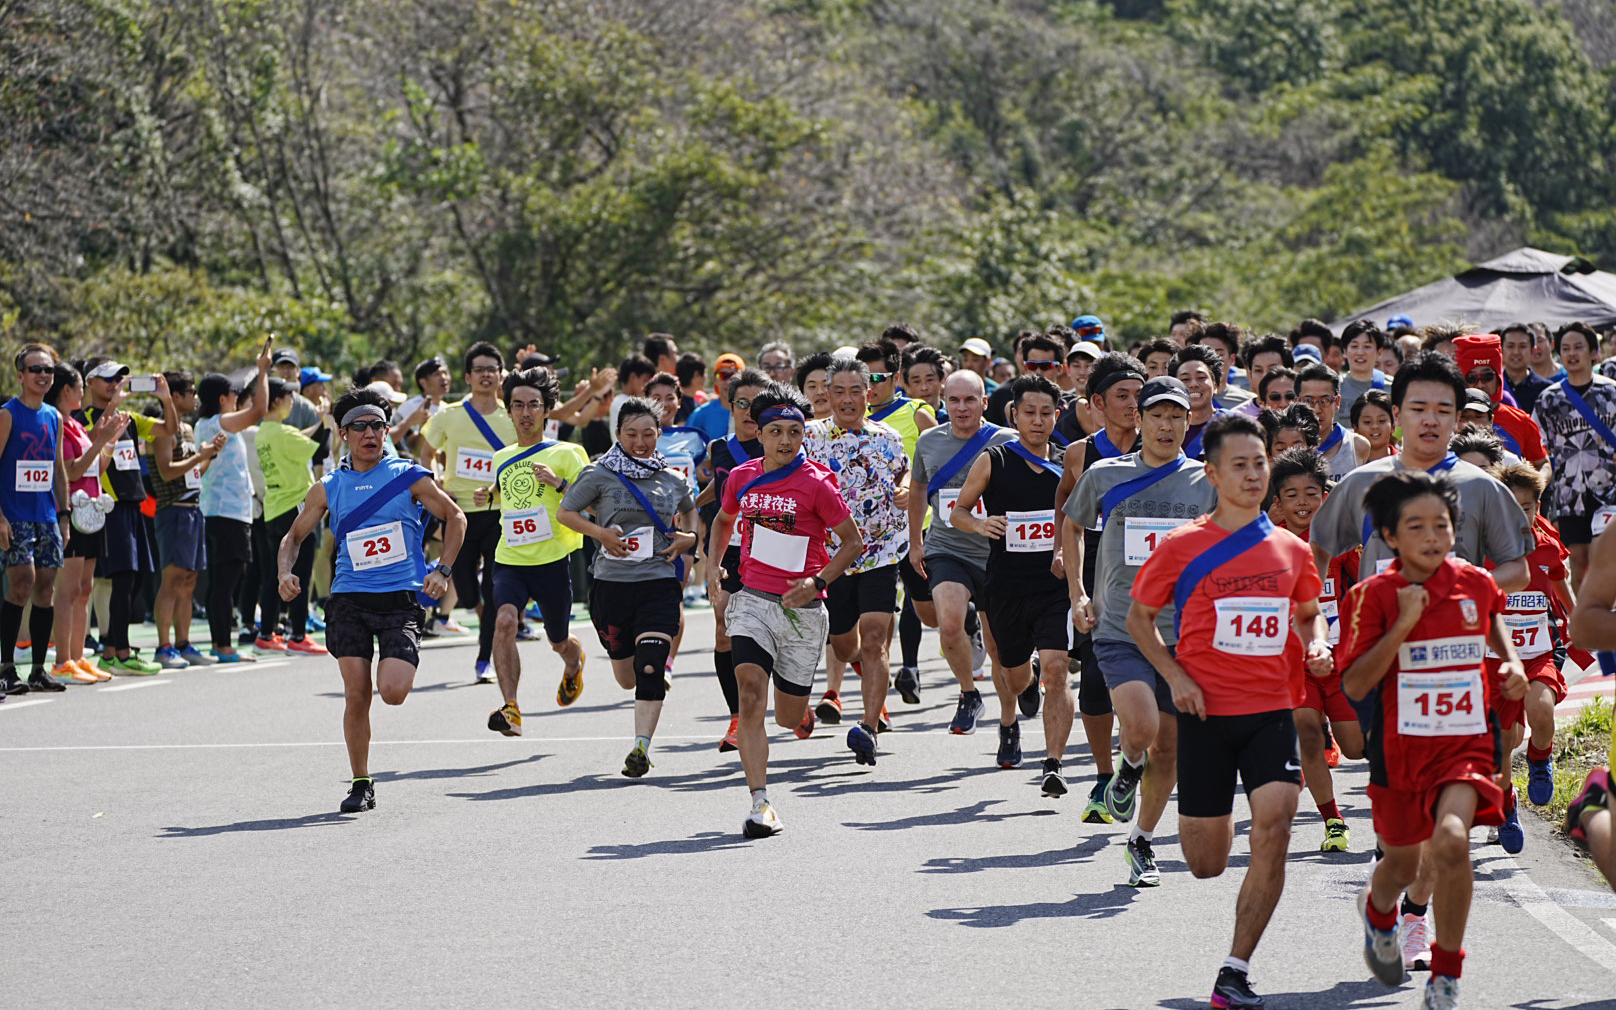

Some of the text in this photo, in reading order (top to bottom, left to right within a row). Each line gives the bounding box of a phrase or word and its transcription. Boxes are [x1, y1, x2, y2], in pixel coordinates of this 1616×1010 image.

[464, 458, 492, 472] 141
[24, 470, 49, 482] 102
[536, 483, 545, 498] RUN
[513, 519, 537, 535] 56
[1016, 522, 1055, 540] 129
[363, 537, 391, 557] 23
[1216, 576, 1279, 592] NIKE
[1507, 594, 1547, 608] 新昭和
[1231, 615, 1279, 638] 148
[1432, 643, 1481, 660] 新昭和
[1415, 690, 1473, 717] 154
